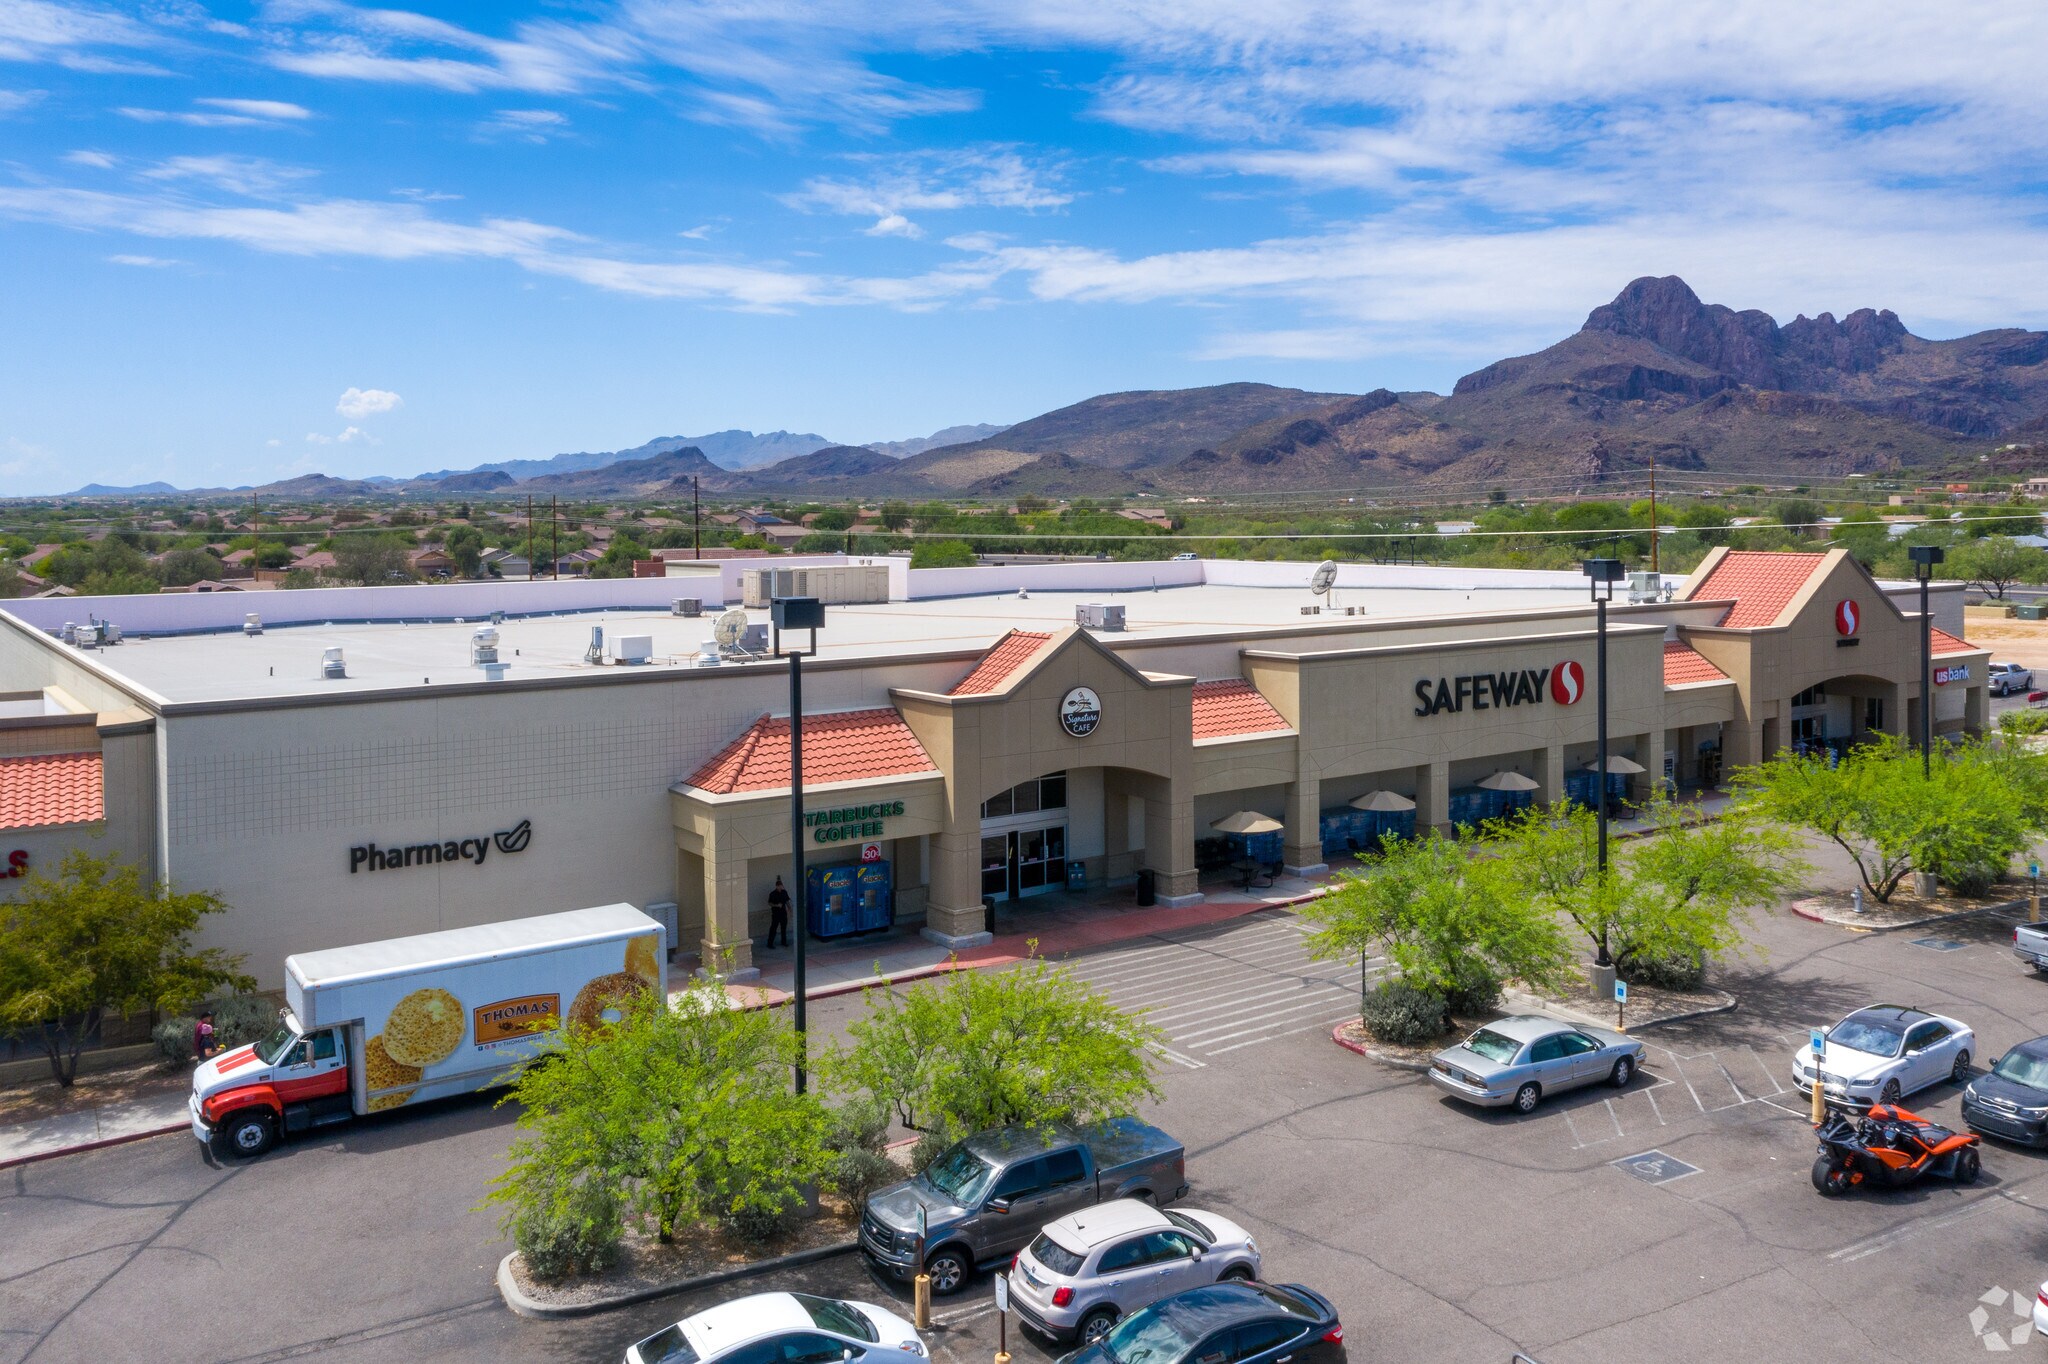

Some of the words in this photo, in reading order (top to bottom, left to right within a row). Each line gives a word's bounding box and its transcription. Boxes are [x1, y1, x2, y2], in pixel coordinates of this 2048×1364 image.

[1936, 671, 1948, 683] us
[1948, 665, 1970, 681] bank
[1415, 669, 1550, 717] SAFEWAY
[1066, 713, 1098, 725] Signature
[1073, 723, 1091, 732] CAFE
[803, 801, 904, 827] TARBUCKS
[814, 821, 884, 843] COFFEE
[350, 837, 490, 873] Pharmacy
